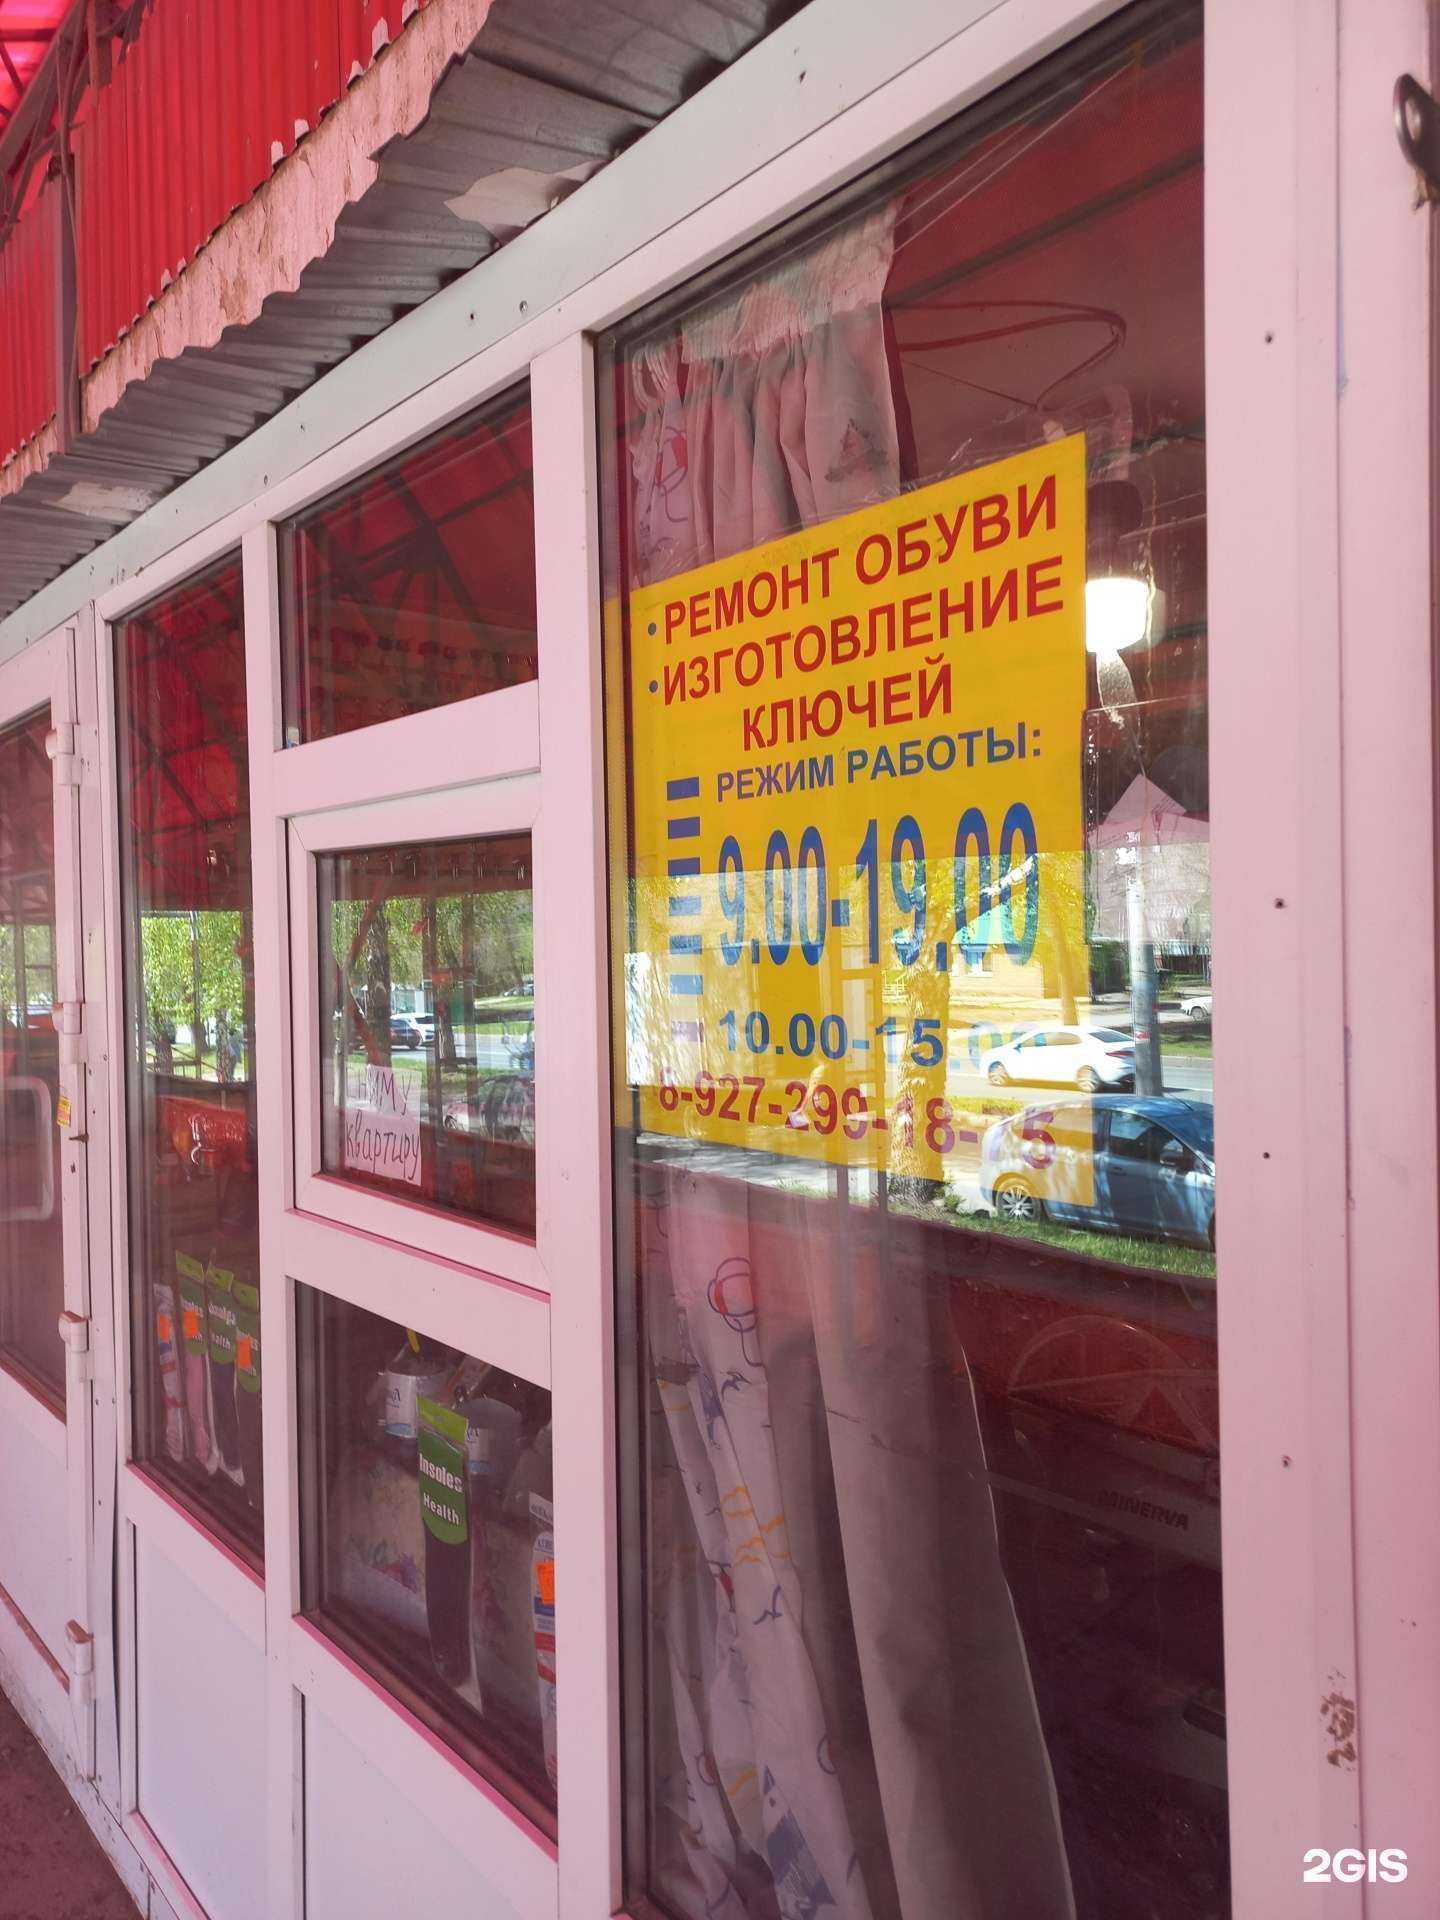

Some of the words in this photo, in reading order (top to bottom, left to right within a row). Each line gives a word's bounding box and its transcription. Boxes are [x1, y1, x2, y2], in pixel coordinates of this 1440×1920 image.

[664, 548, 840, 644] РЕМОНТ
[855, 475, 1057, 584] ОБУВИ
[664, 556, 1064, 705] ИЗГОТОВЛЕНИЕ
[742, 655, 953, 751] КЛЮЧЕЙ
[717, 757, 835, 802] РЕЖИМ
[847, 722, 1042, 784] РАБОТЫ:
[718, 802, 1040, 973] 9.00-19.00
[658, 1066, 1057, 1170] 8-927-299-18-5
[418, 1453, 465, 1493] Insoles
[423, 1492, 460, 1526] Health
